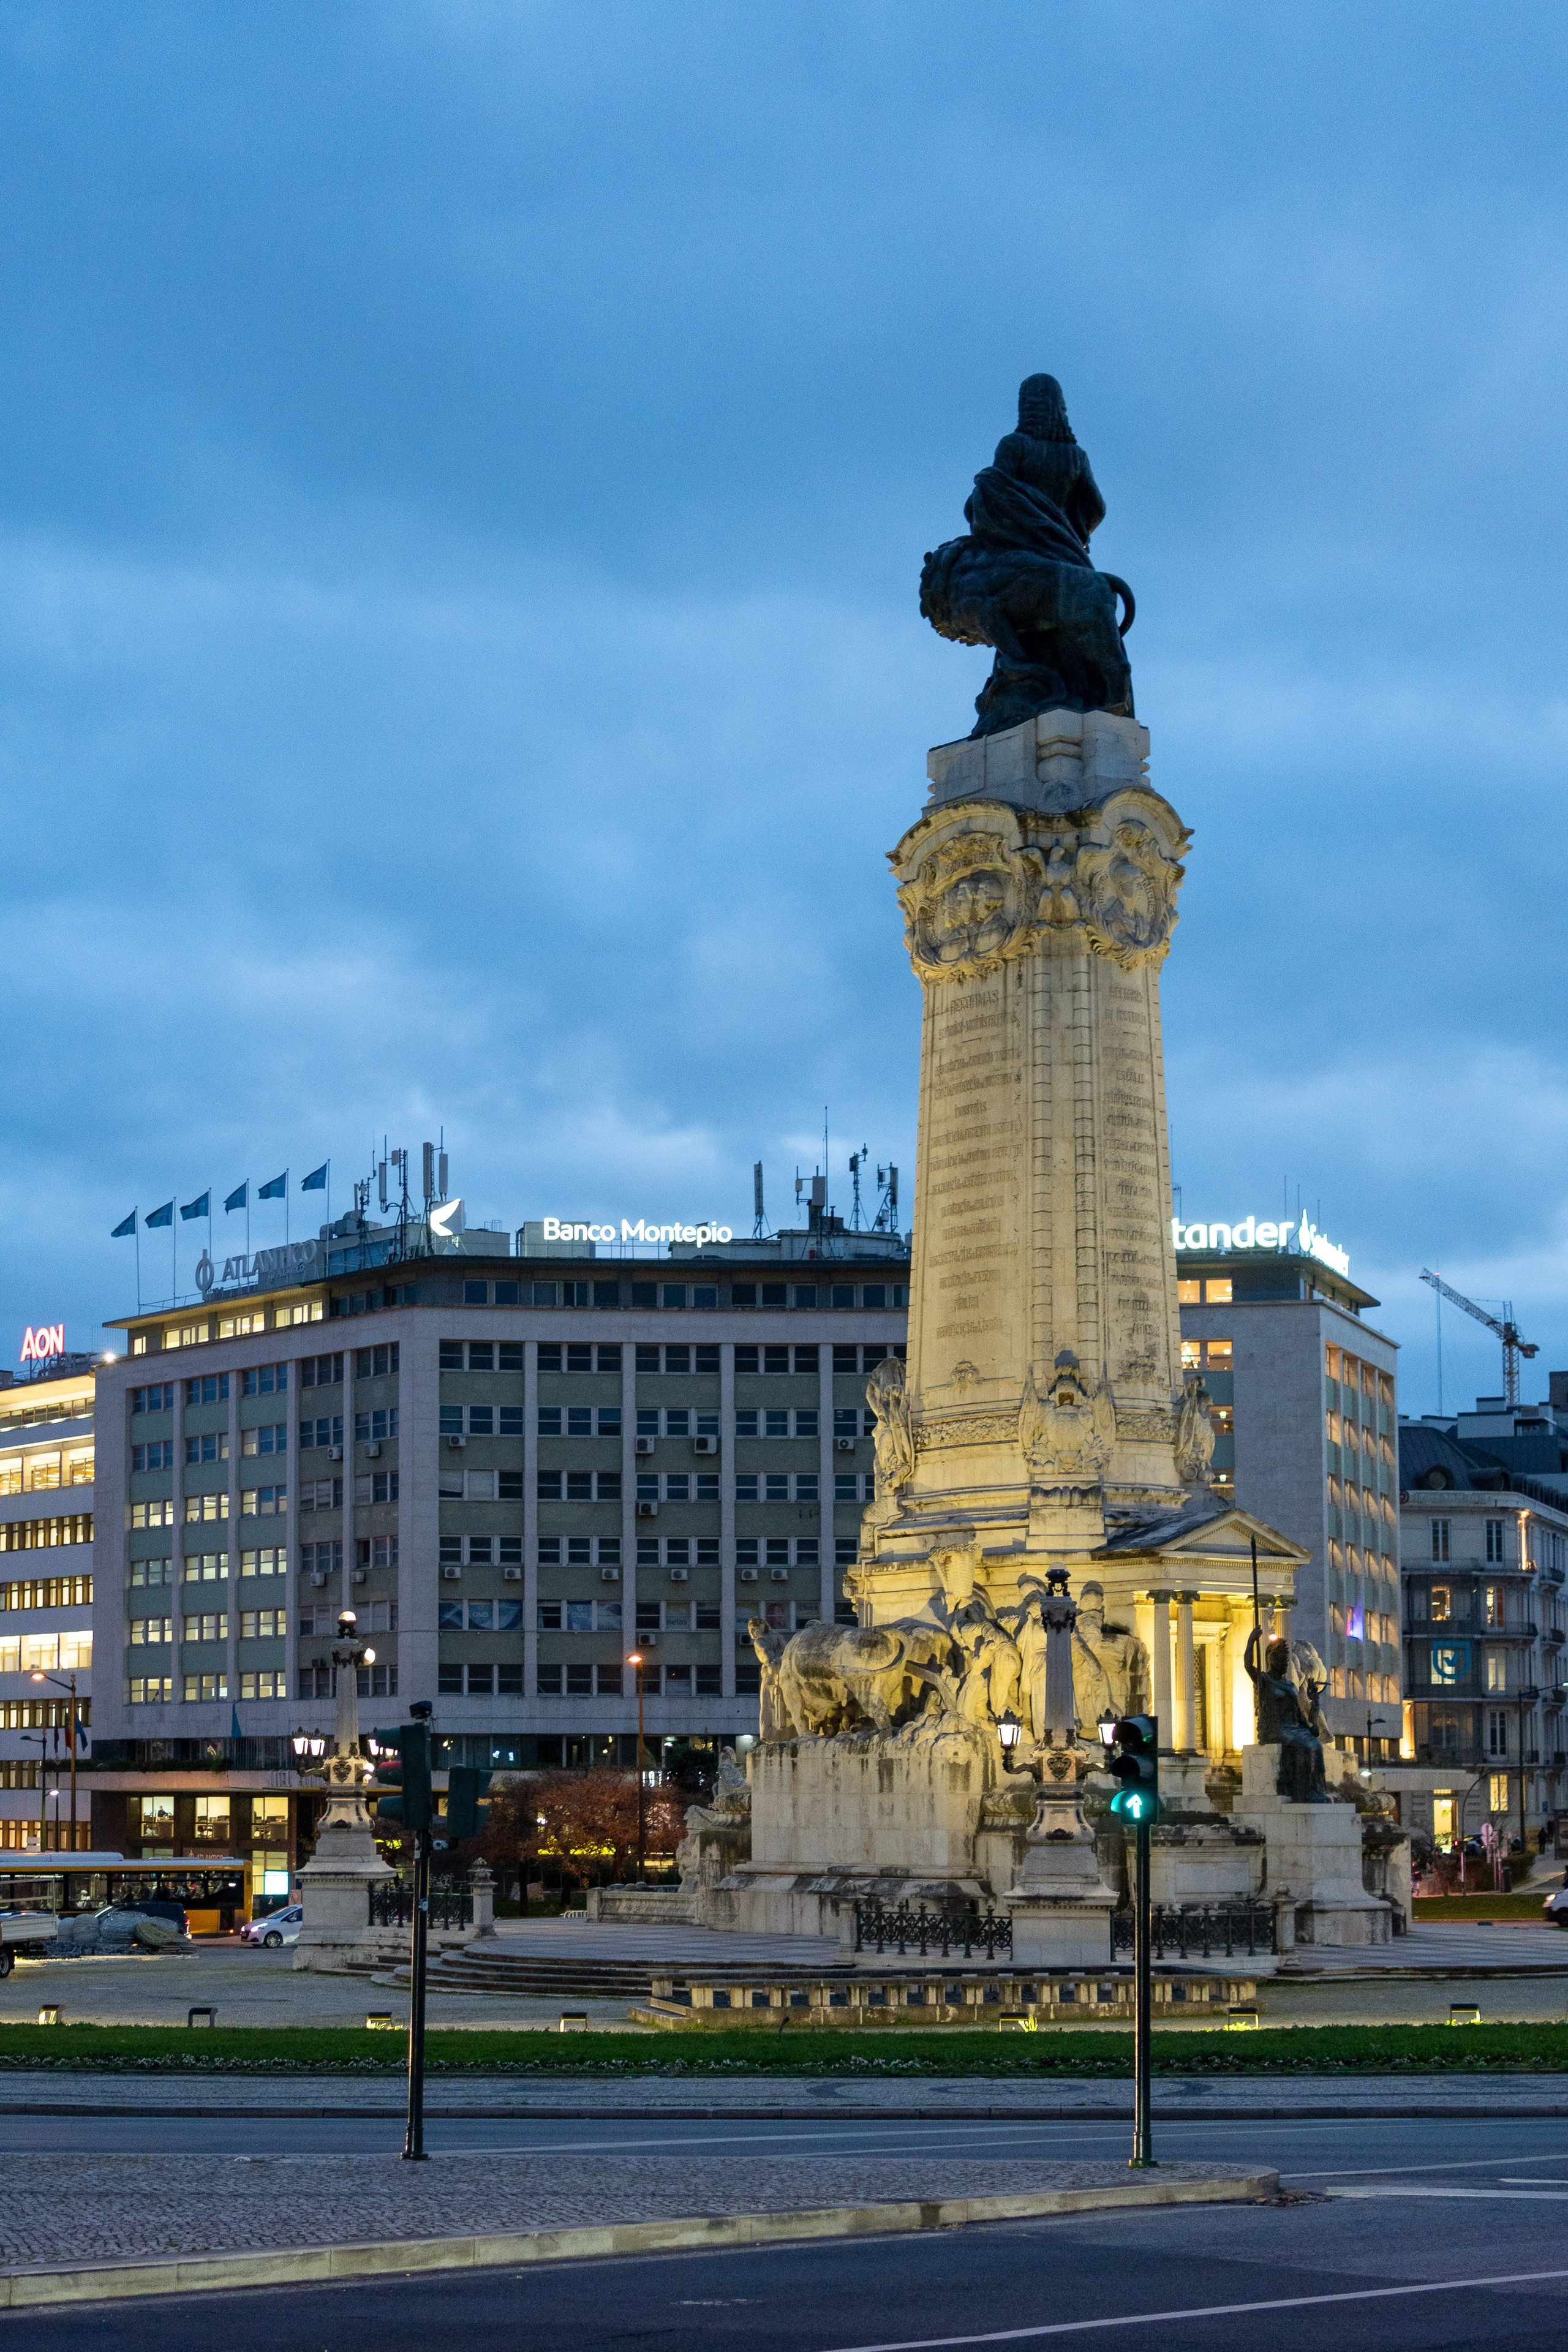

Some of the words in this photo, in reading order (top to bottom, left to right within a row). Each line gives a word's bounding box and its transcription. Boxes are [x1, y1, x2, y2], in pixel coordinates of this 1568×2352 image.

[544, 1217, 616, 1242] Banco
[622, 1219, 733, 1248] Montepio
[20, 1324, 64, 1362] AON
